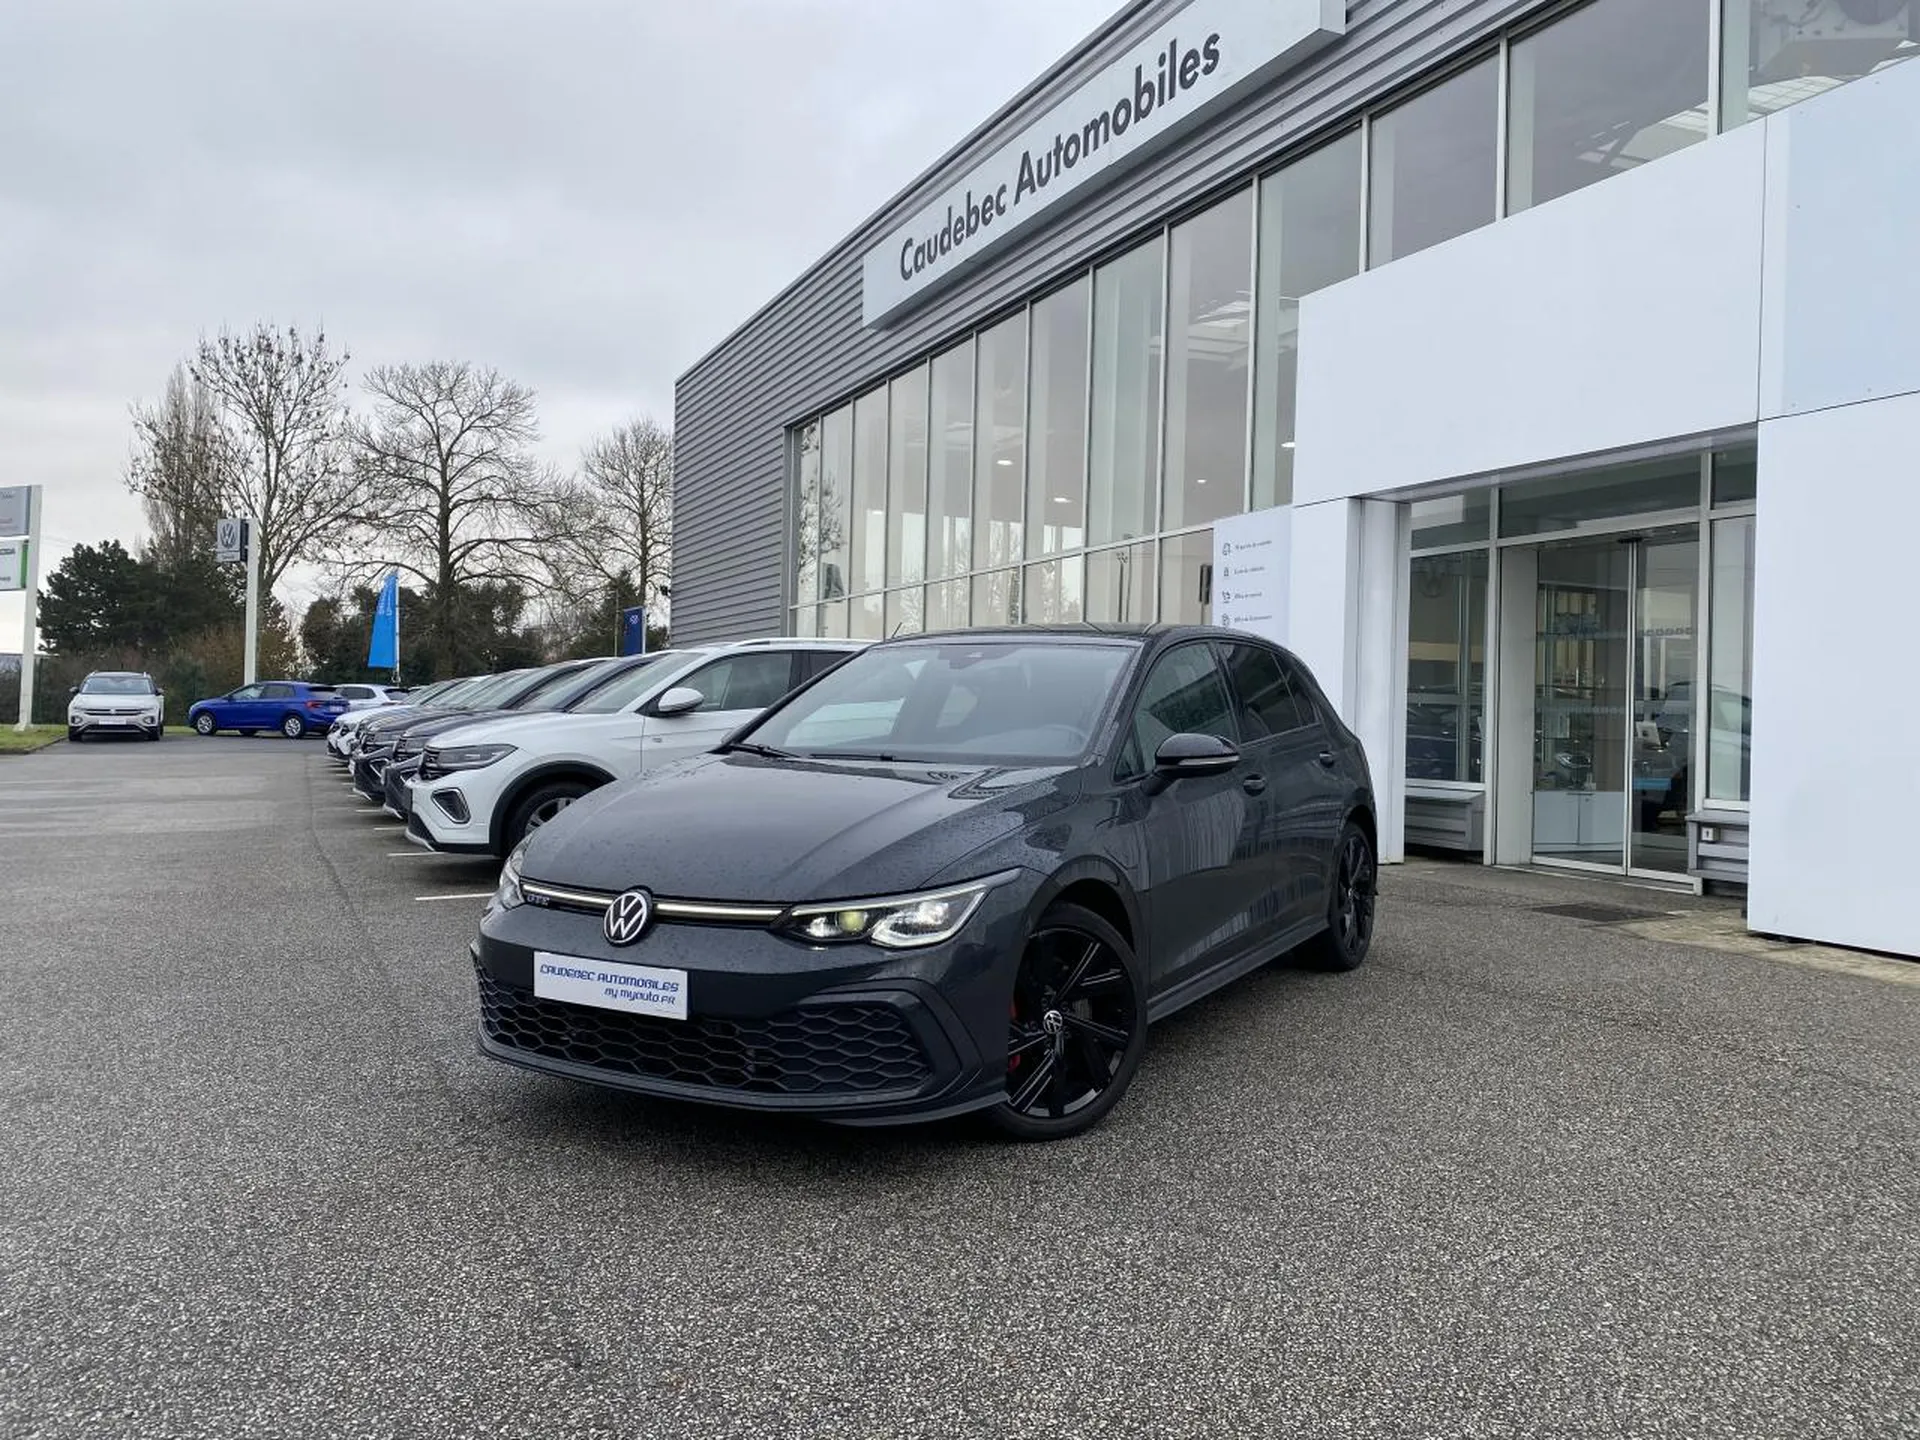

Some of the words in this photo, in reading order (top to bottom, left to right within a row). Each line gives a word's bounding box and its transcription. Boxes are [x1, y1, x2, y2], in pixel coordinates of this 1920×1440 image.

[900, 183, 1007, 282] Caudebec
[1013, 33, 1220, 206] Automobiles
[540, 964, 596, 982] CAUDEBEC
[597, 973, 679, 992] AUTOMOBILES
